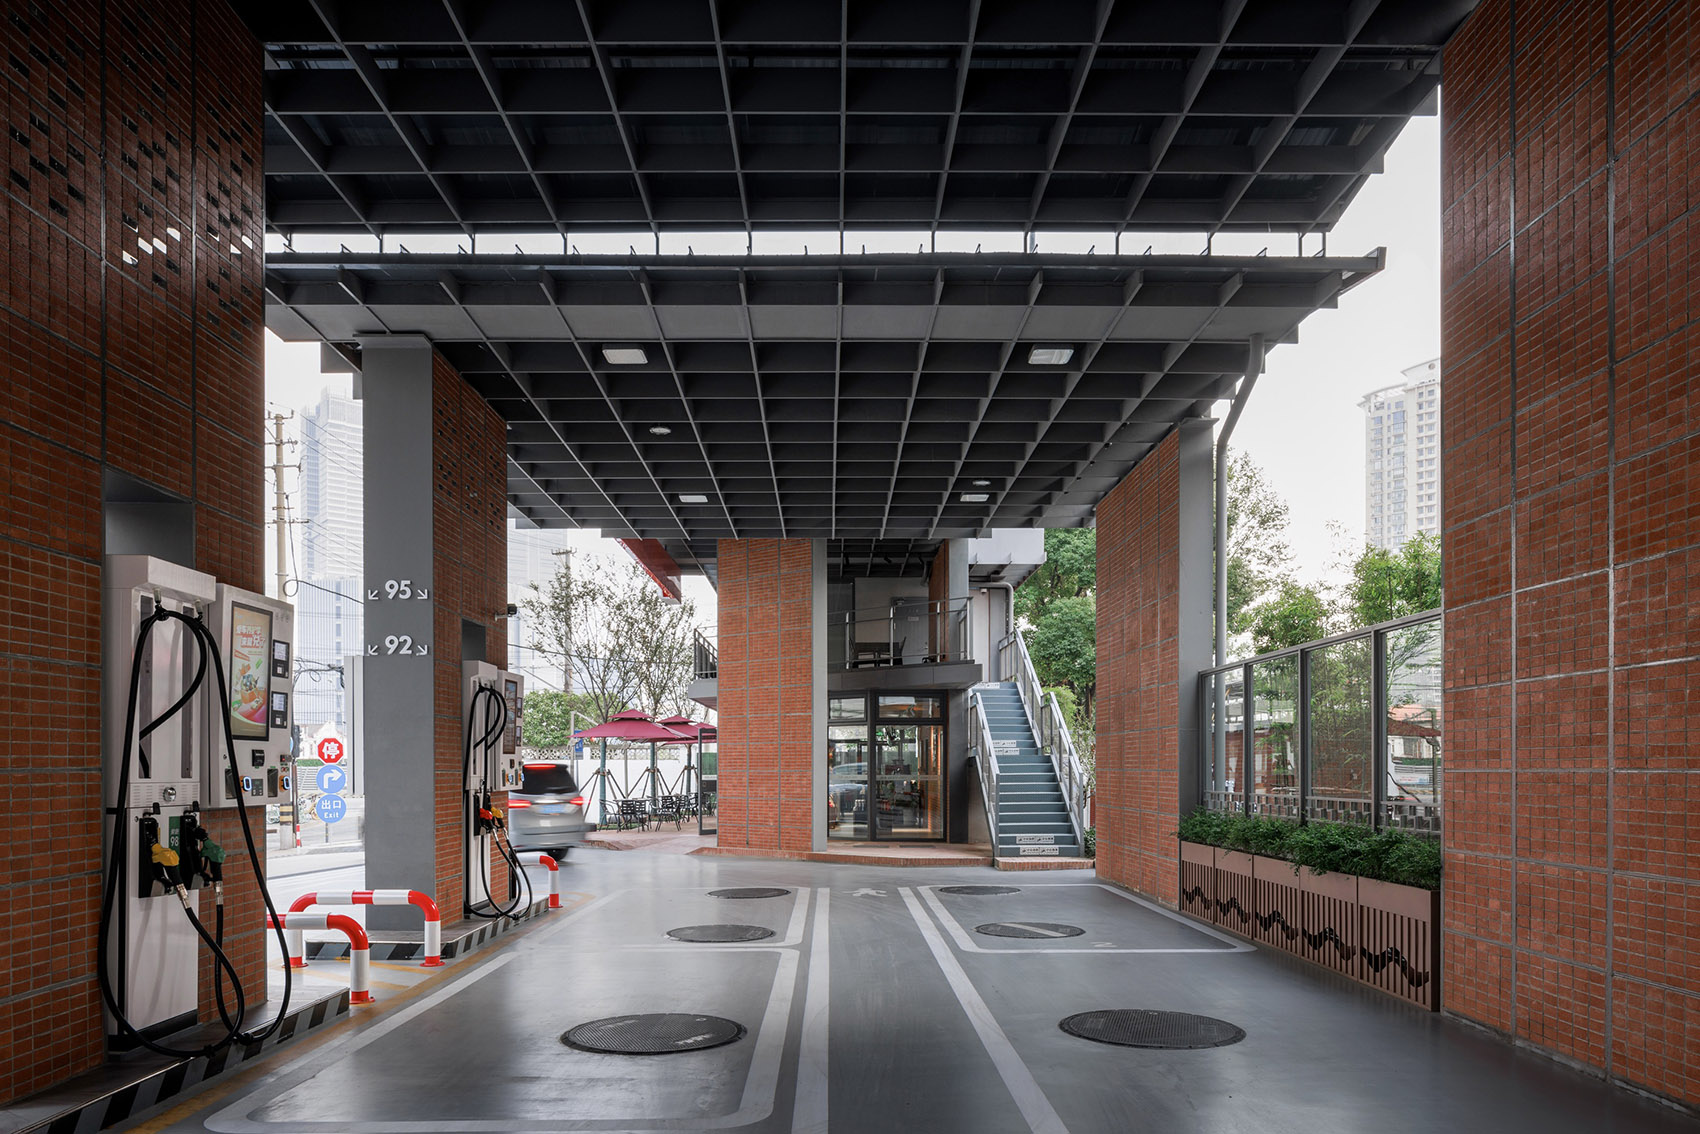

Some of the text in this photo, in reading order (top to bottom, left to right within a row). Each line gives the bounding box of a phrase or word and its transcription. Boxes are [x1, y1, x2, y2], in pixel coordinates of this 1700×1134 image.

[385, 580, 412, 599] 95
[385, 635, 412, 655] 92
[322, 742, 339, 759] 停
[321, 800, 342, 810] 出口
[170, 836, 180, 847] 98
